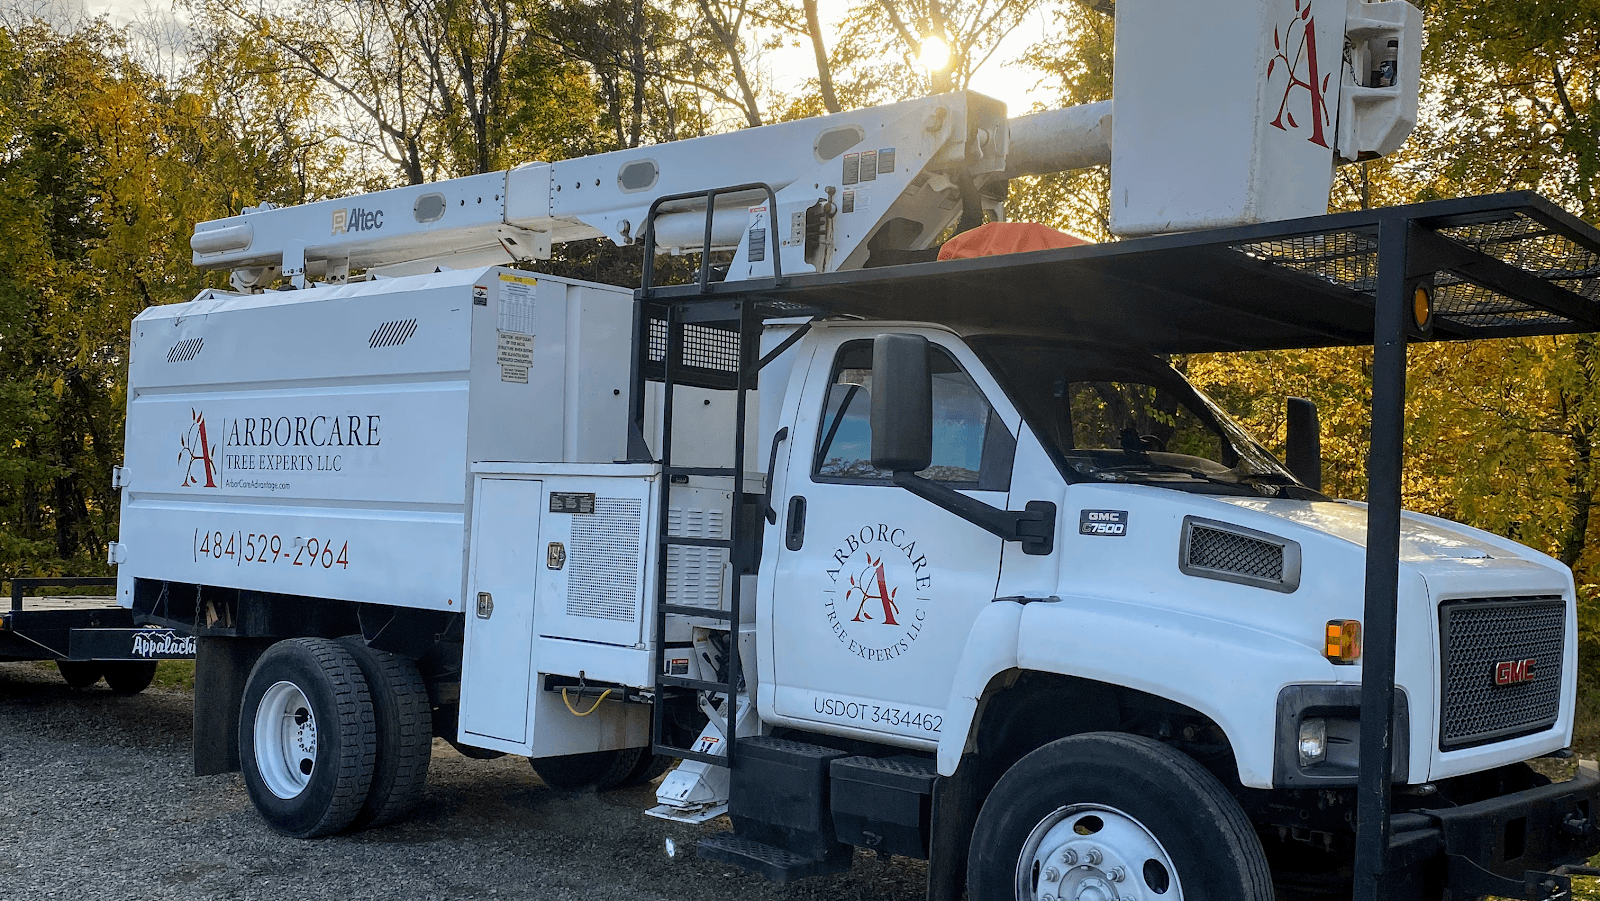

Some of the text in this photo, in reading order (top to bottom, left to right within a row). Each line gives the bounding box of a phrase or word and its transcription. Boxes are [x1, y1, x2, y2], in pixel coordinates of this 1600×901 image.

[347, 208, 384, 232] Altec
[227, 415, 381, 447] ARBORCARE
[226, 454, 342, 472] TREE EXPERTS LLC
[225, 479, 291, 491] ArborCareAdvantage.com
[1081, 522, 1125, 534] C7500
[1088, 512, 1120, 521] GMC
[193, 527, 349, 570] (484)529-2964
[826, 523, 931, 592] ARBORCARE
[824, 598, 926, 662] TREE EXPERTS LLC
[1495, 658, 1537, 685] GMC
[814, 697, 943, 733] USDOT 3434462
